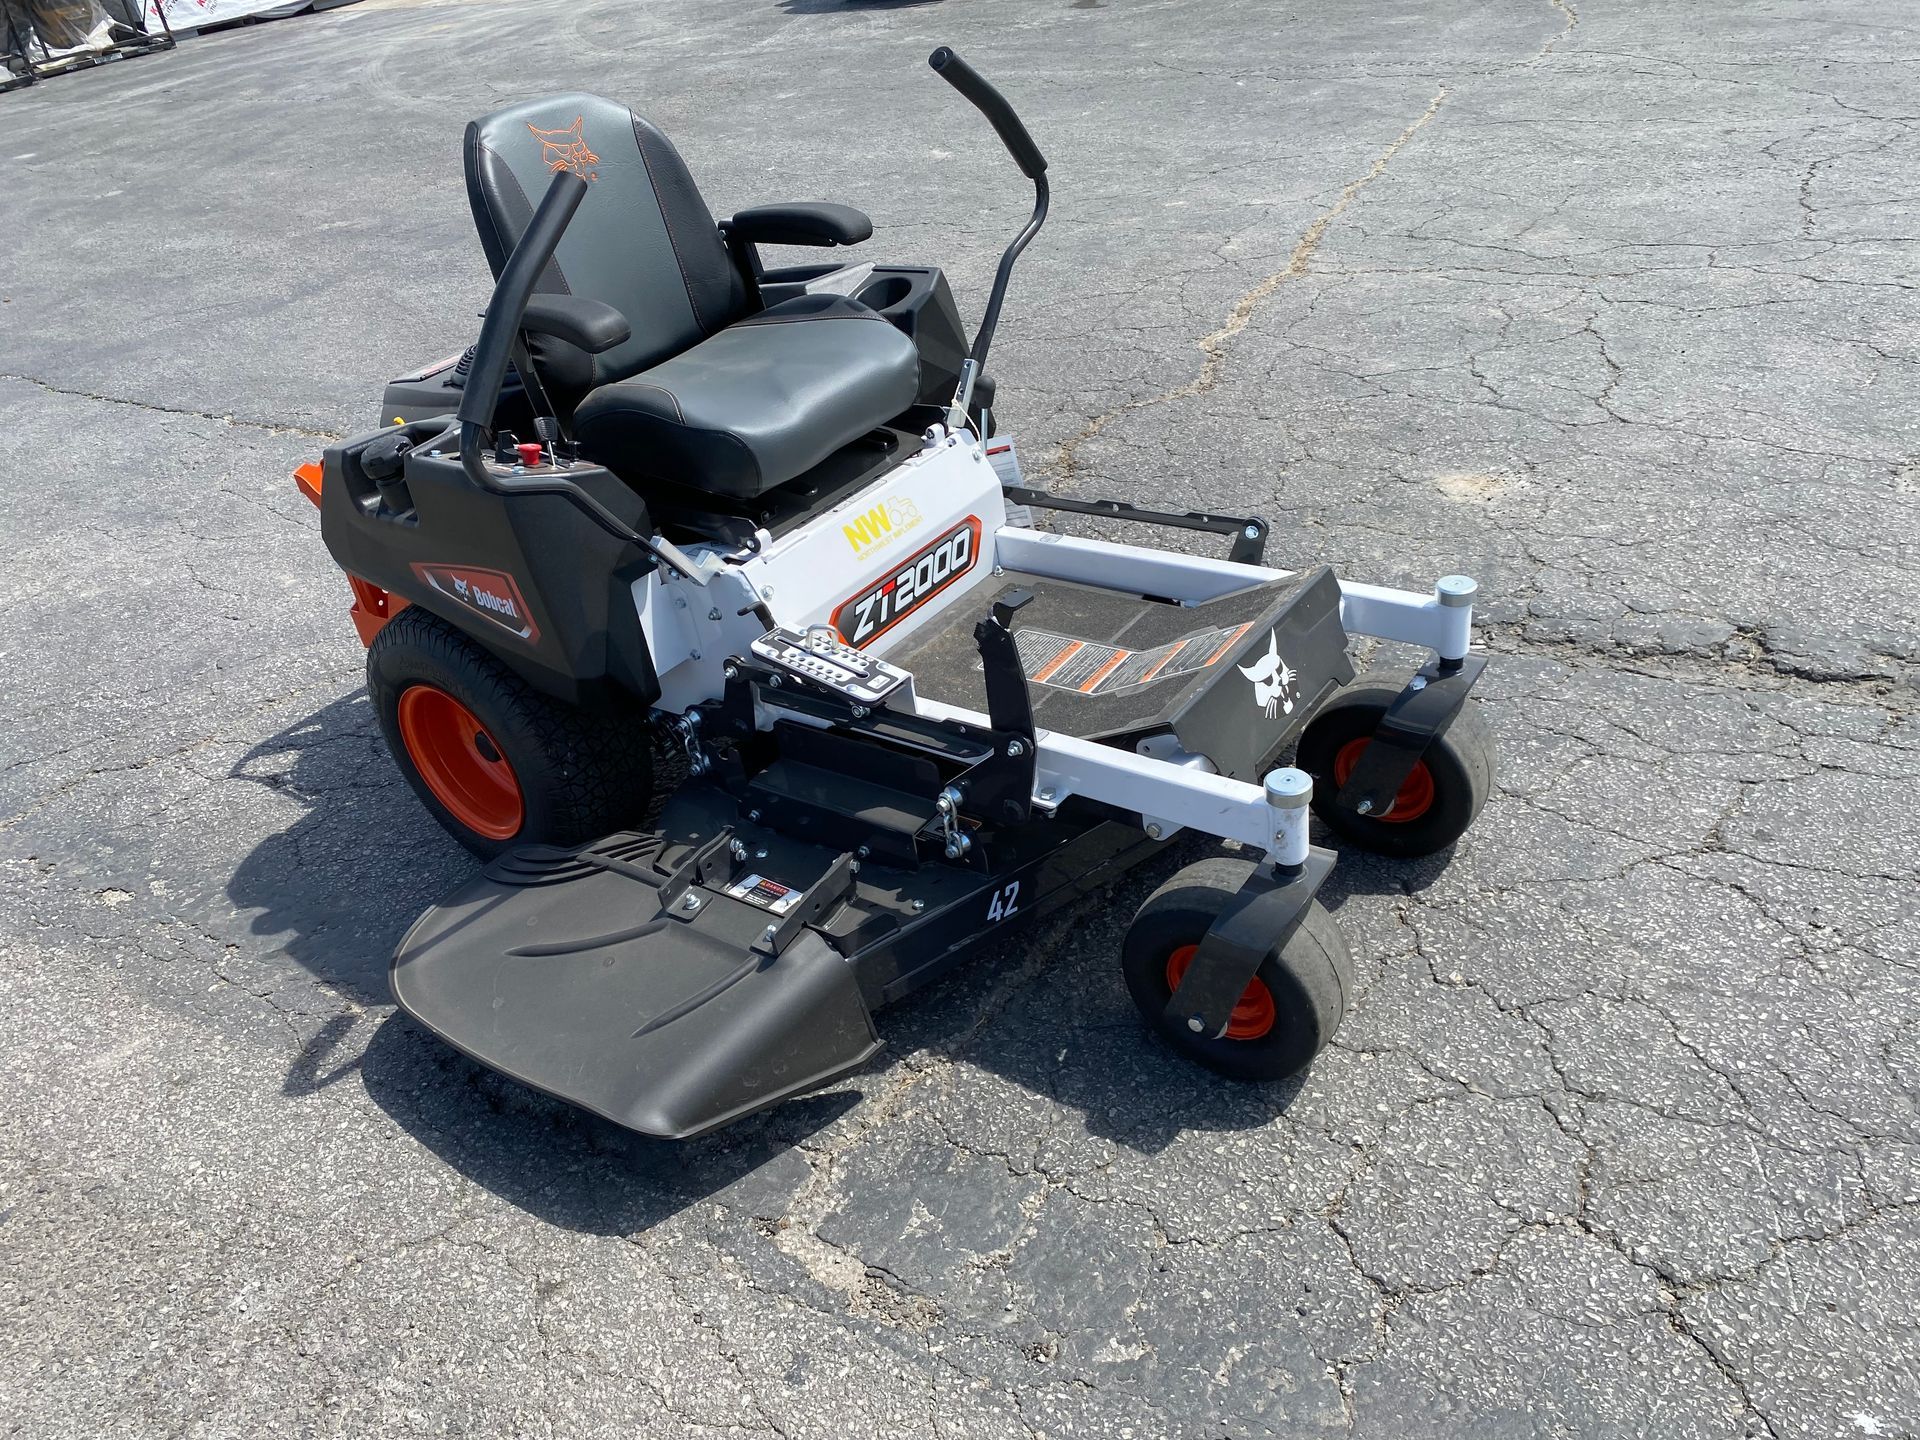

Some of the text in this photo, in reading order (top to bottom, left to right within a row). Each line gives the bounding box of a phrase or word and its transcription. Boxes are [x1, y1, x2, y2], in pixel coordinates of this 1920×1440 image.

[842, 503, 892, 553] NW
[472, 585, 518, 618] Bobcat
[852, 527, 971, 643] ZT2000
[987, 880, 1020, 922] 42
